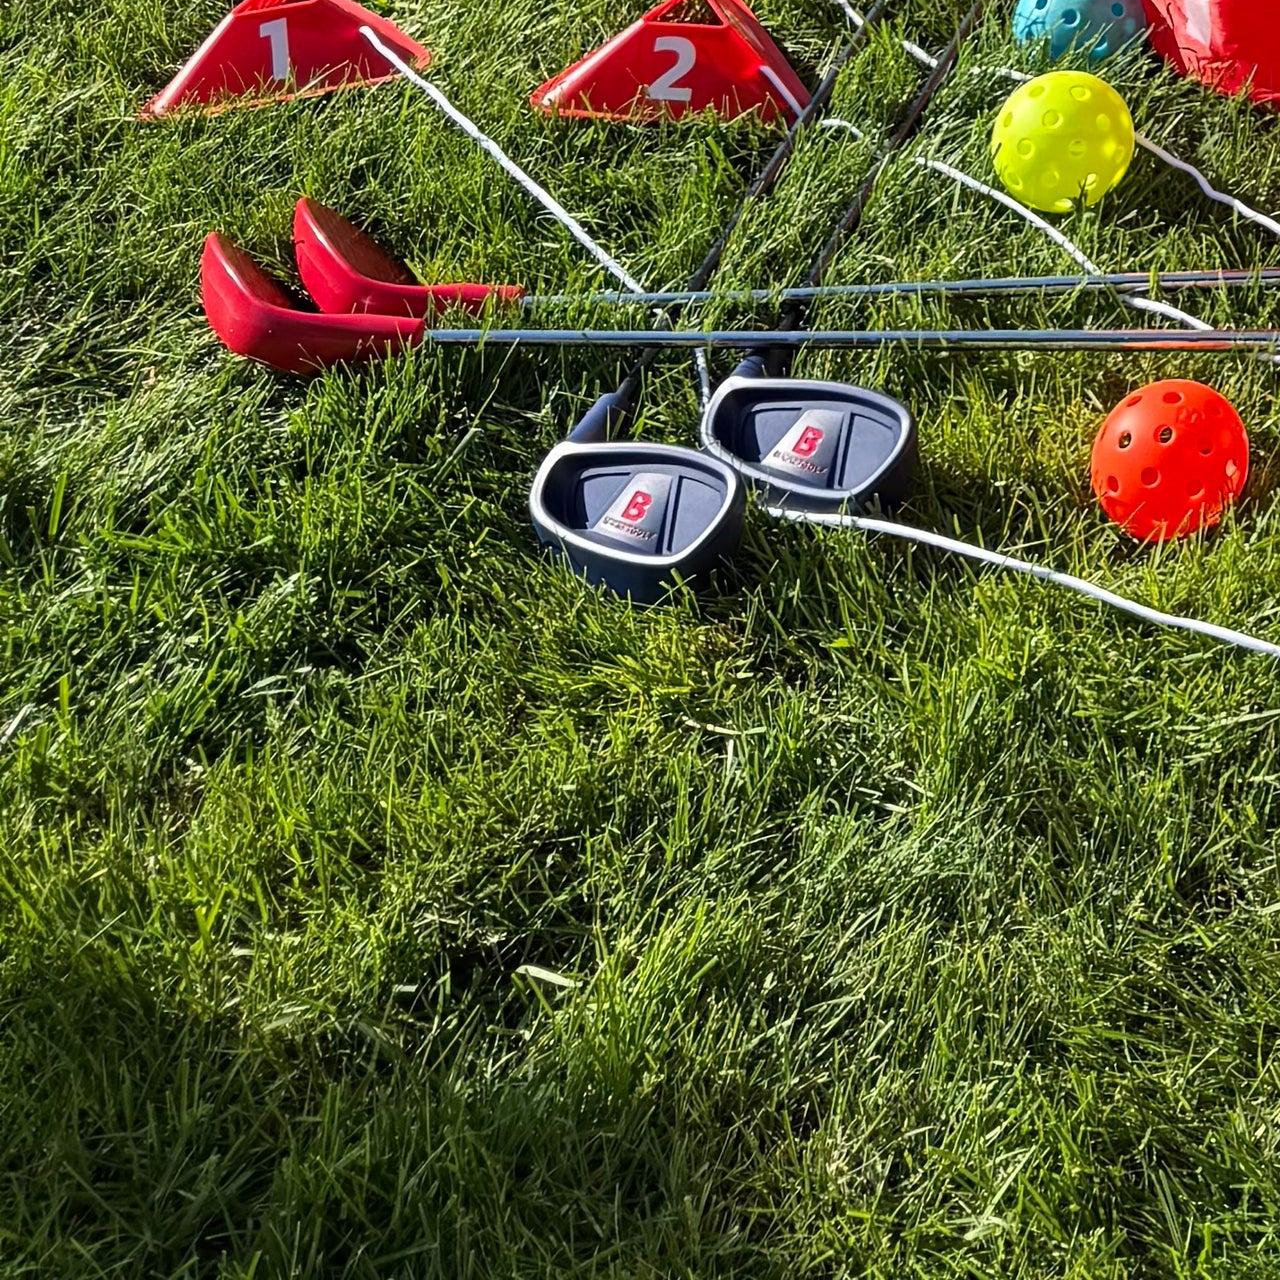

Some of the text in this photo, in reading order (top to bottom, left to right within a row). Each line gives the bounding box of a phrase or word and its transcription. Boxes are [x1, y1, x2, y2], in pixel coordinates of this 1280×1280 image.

[260, 17, 289, 81] 1
[648, 36, 697, 102] 2
[792, 426, 824, 457] B
[621, 491, 652, 522] B
